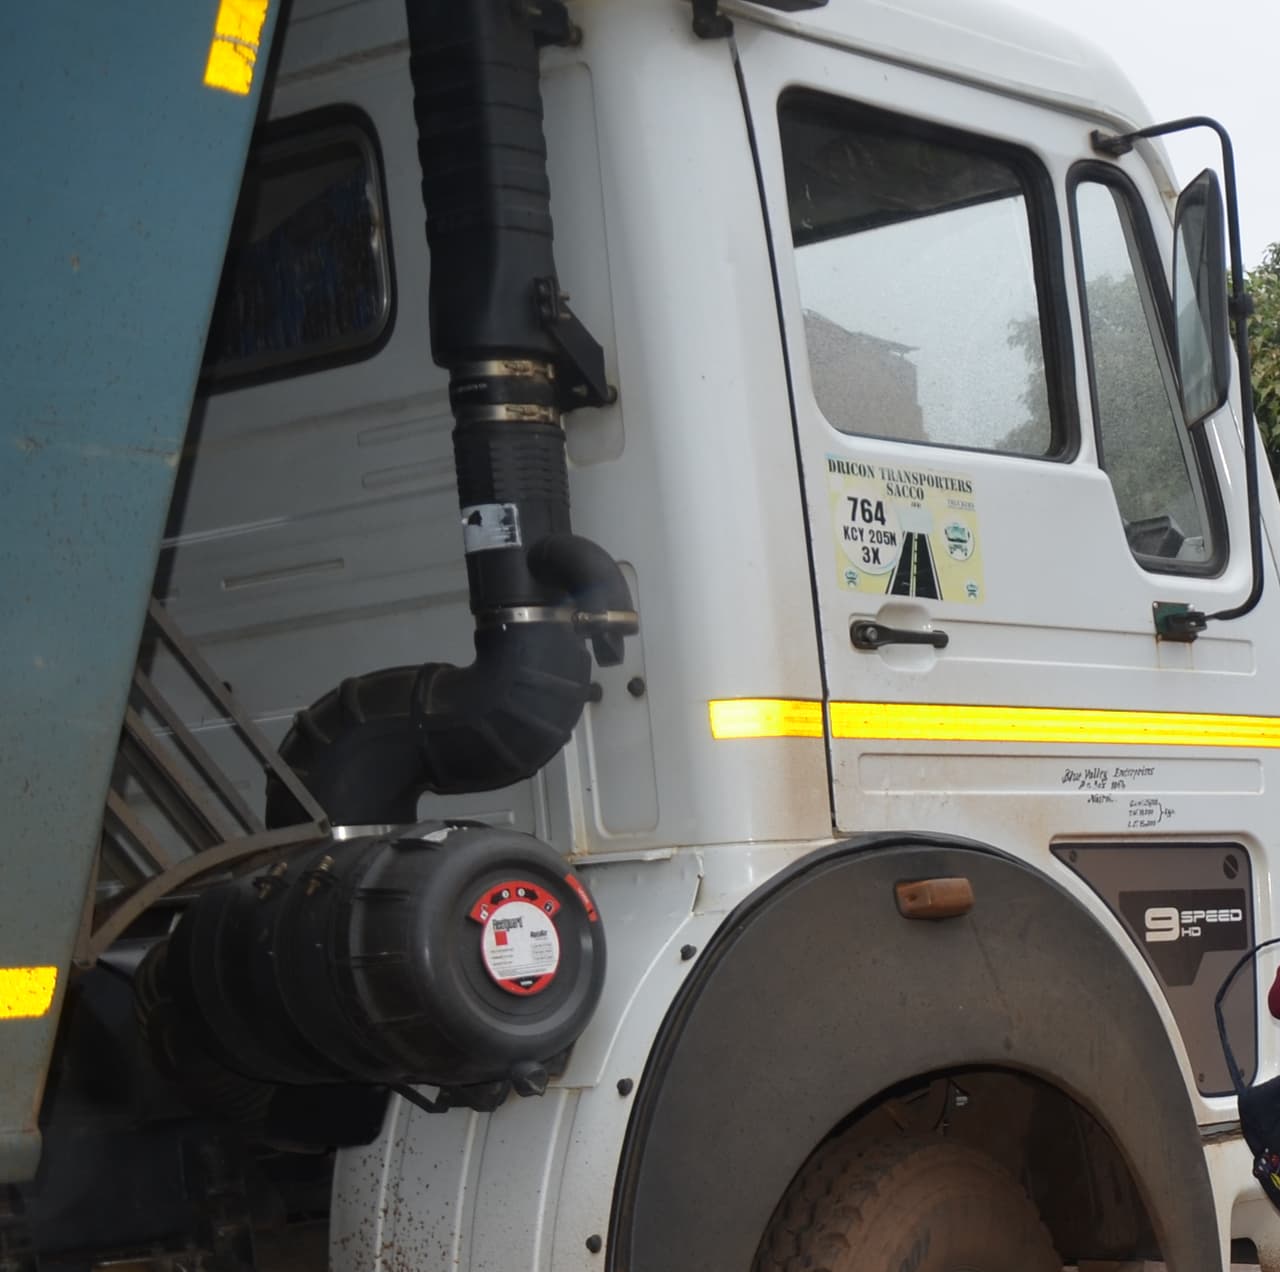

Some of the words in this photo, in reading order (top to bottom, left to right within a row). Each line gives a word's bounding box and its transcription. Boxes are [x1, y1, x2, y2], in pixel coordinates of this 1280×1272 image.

[828, 459, 875, 479] DRICON
[878, 467, 973, 494] TRANSPORTERS
[886, 482, 925, 501] SACCO
[847, 495, 886, 526] 764
[843, 525, 865, 543] KCY
[868, 528, 897, 547] 205N
[861, 545, 882, 566] 3X
[1085, 767, 1108, 782] Valley
[1145, 907, 1180, 942] 9
[1181, 909, 1242, 924] SPEED
[1181, 926, 1202, 937] HD
